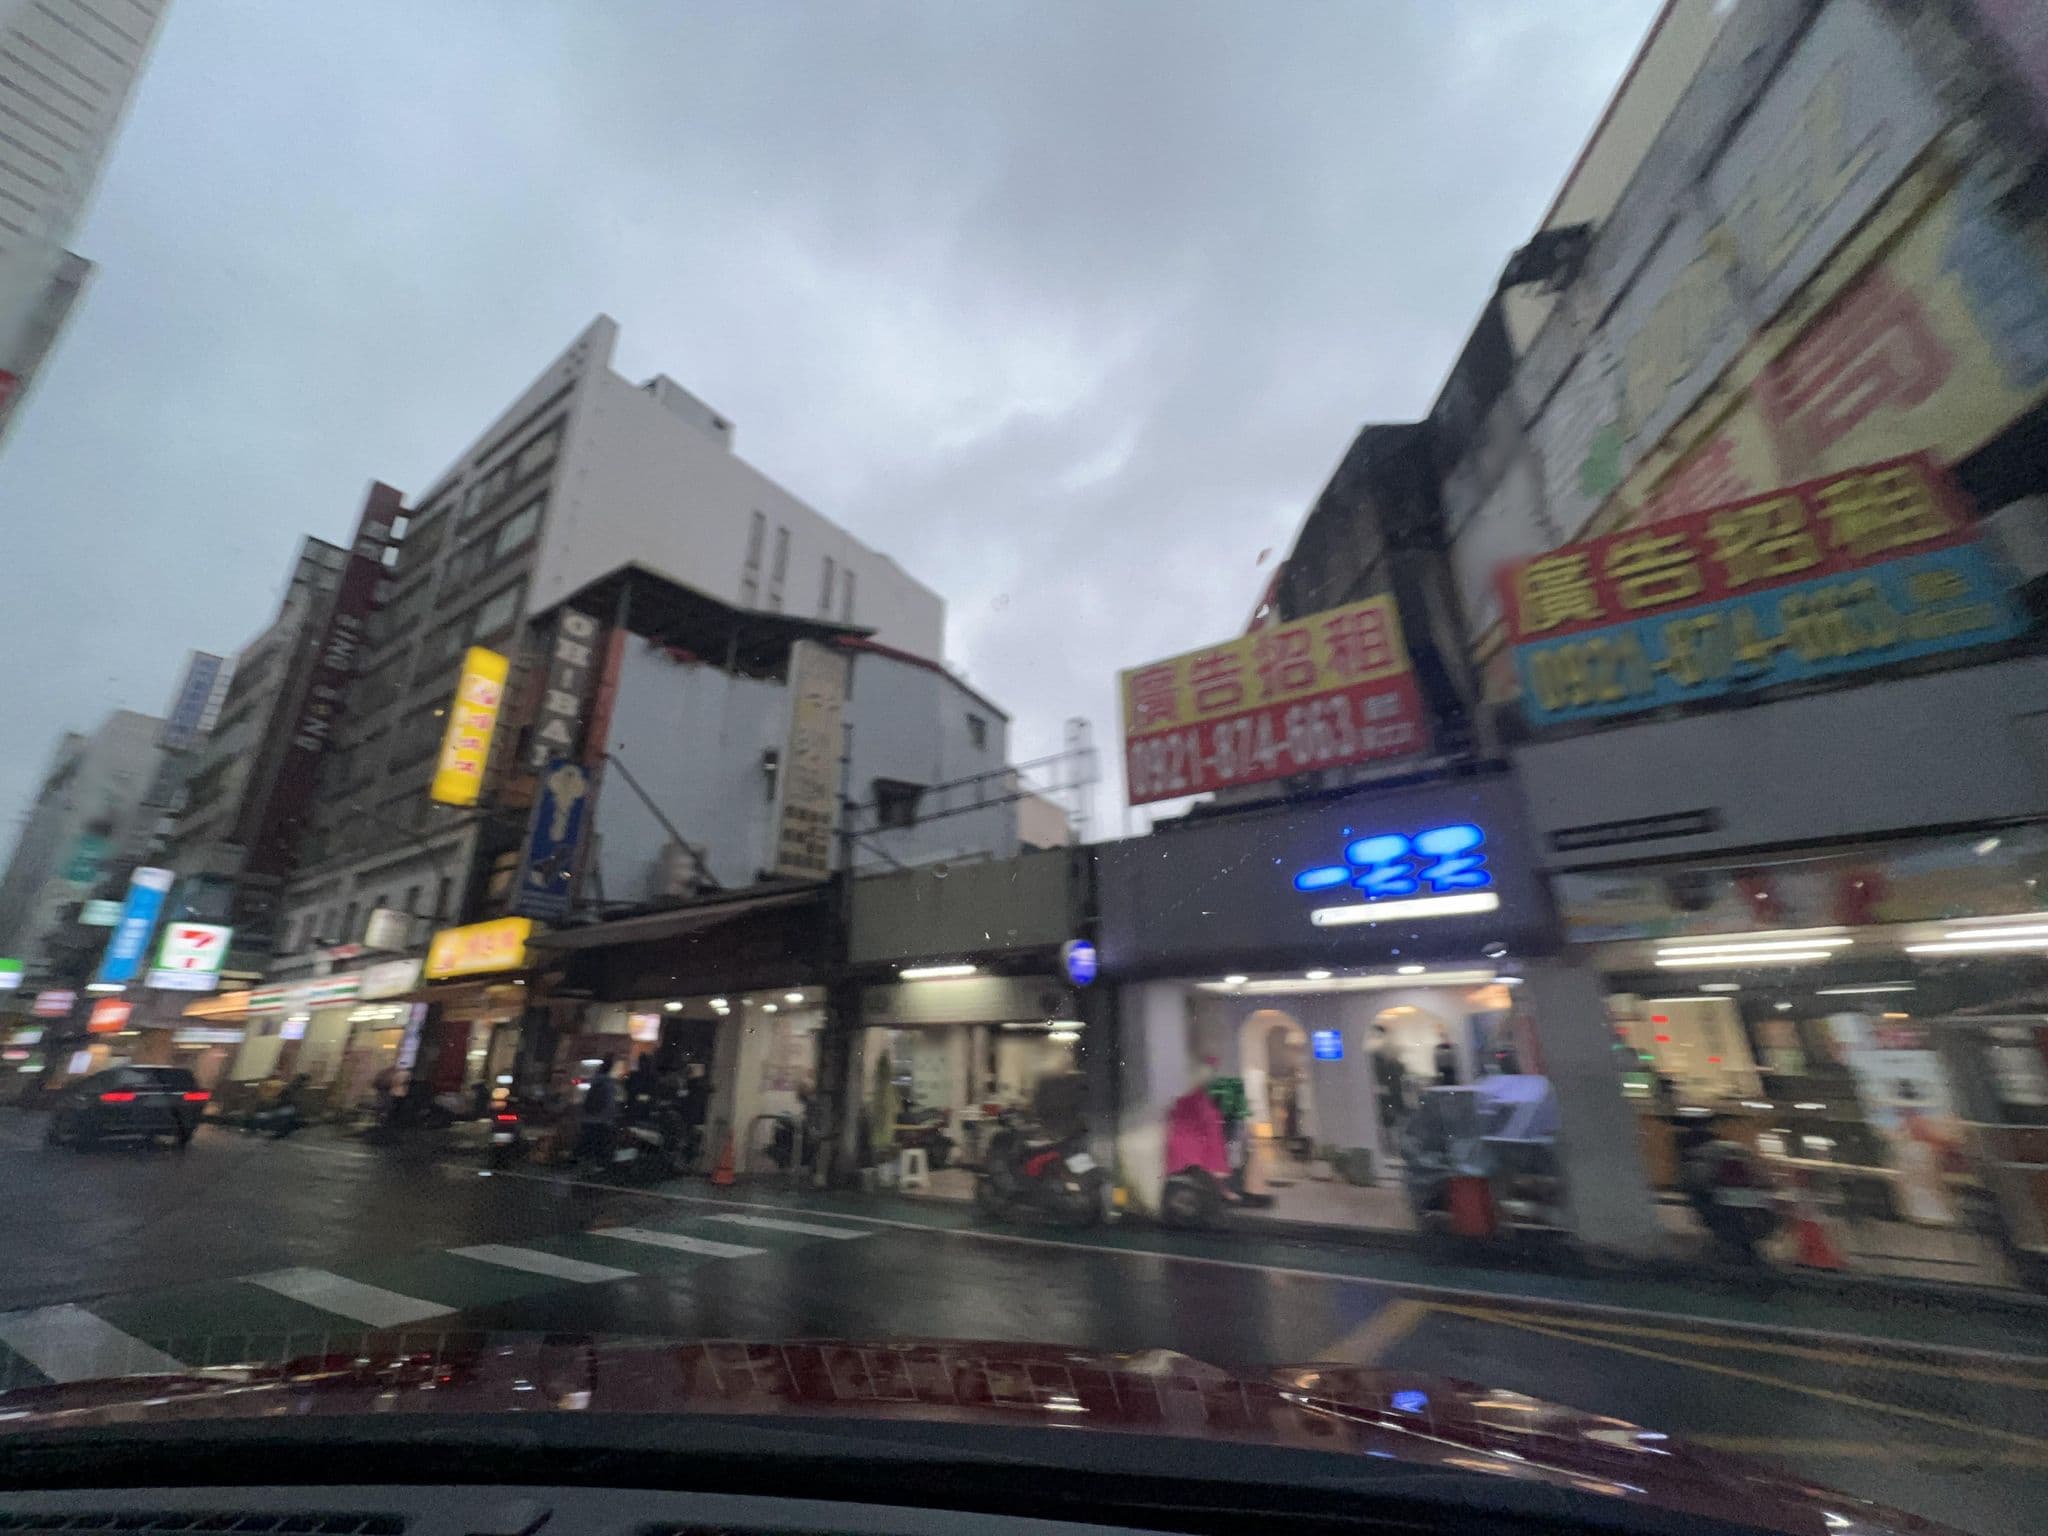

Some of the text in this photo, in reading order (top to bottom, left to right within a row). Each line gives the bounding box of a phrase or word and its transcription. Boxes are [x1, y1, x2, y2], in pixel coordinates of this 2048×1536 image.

[1517, 463, 1962, 637] 廣告招租
[1130, 606, 1394, 728] 廣告招租
